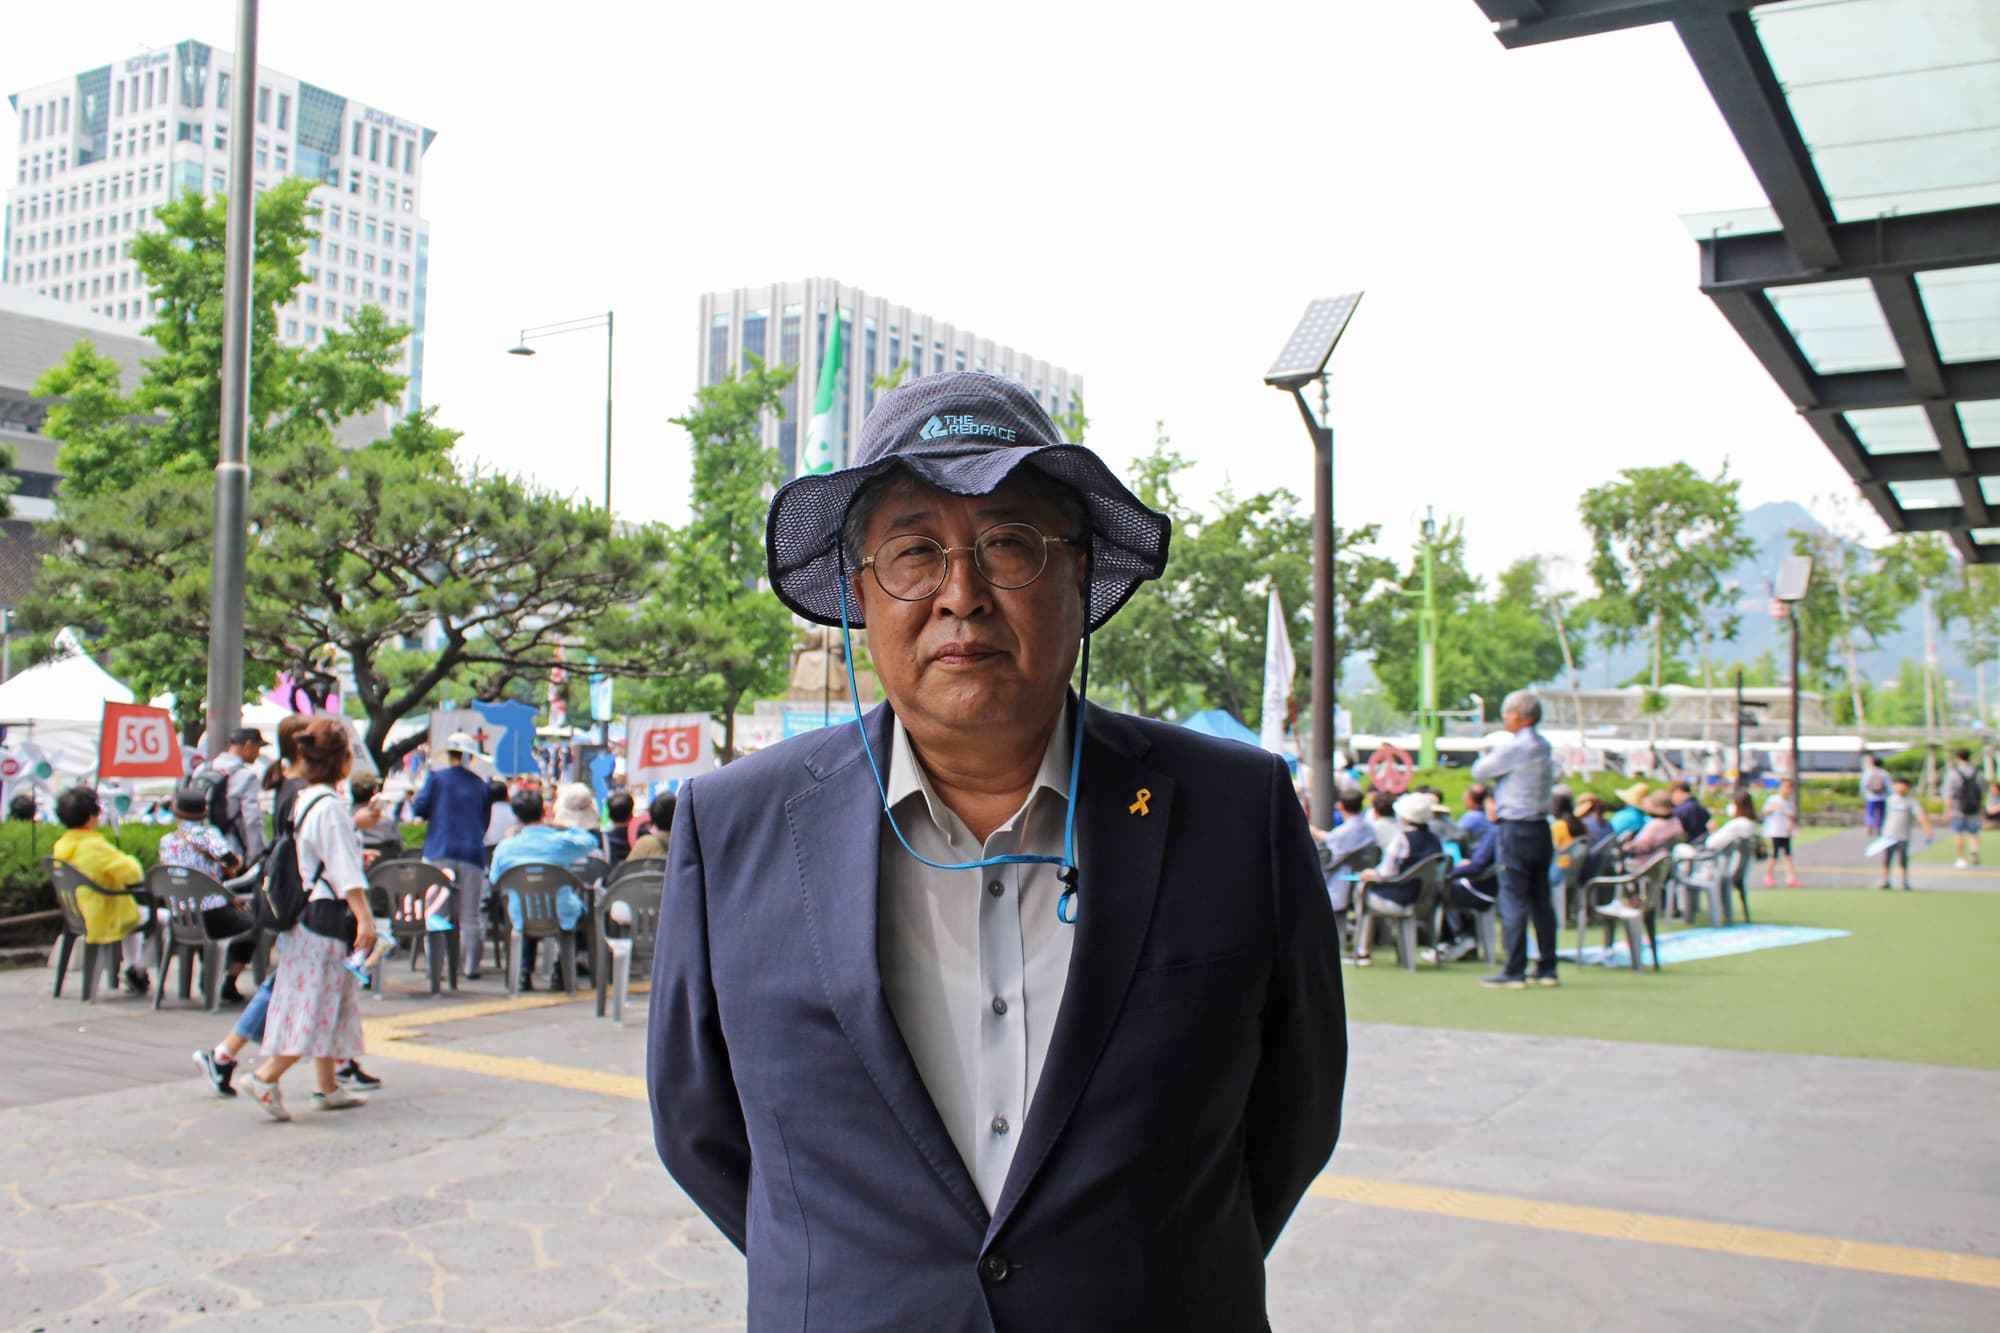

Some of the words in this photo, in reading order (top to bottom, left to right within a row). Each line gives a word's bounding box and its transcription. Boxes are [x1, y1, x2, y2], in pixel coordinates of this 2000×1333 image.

[944, 415, 974, 425] THE
[948, 424, 1017, 442] REDFACE
[126, 724, 160, 755] 5G
[651, 731, 690, 762] 5G
